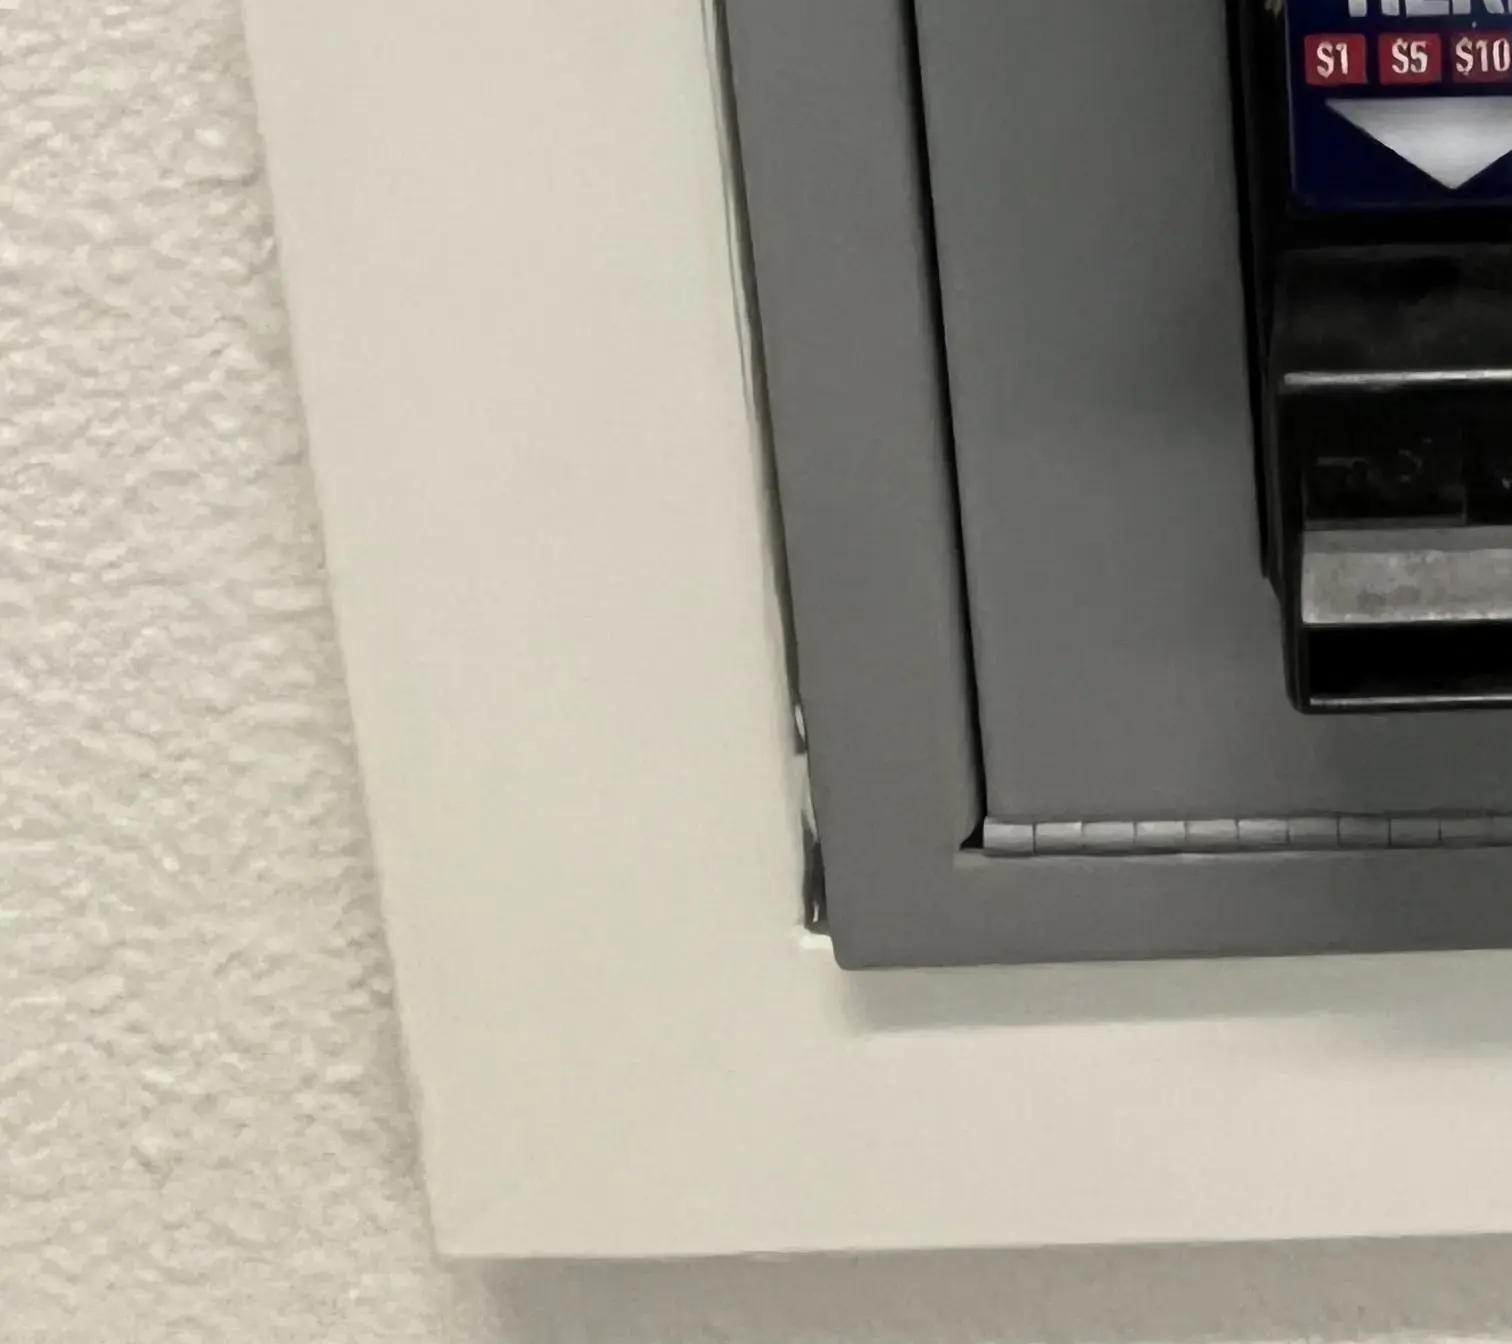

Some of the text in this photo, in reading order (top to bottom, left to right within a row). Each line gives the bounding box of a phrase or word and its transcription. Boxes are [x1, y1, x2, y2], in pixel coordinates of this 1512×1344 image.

[1316, 41, 1349, 79] $1
[1391, 38, 1428, 74] $5
[1454, 36, 1512, 76] $10
